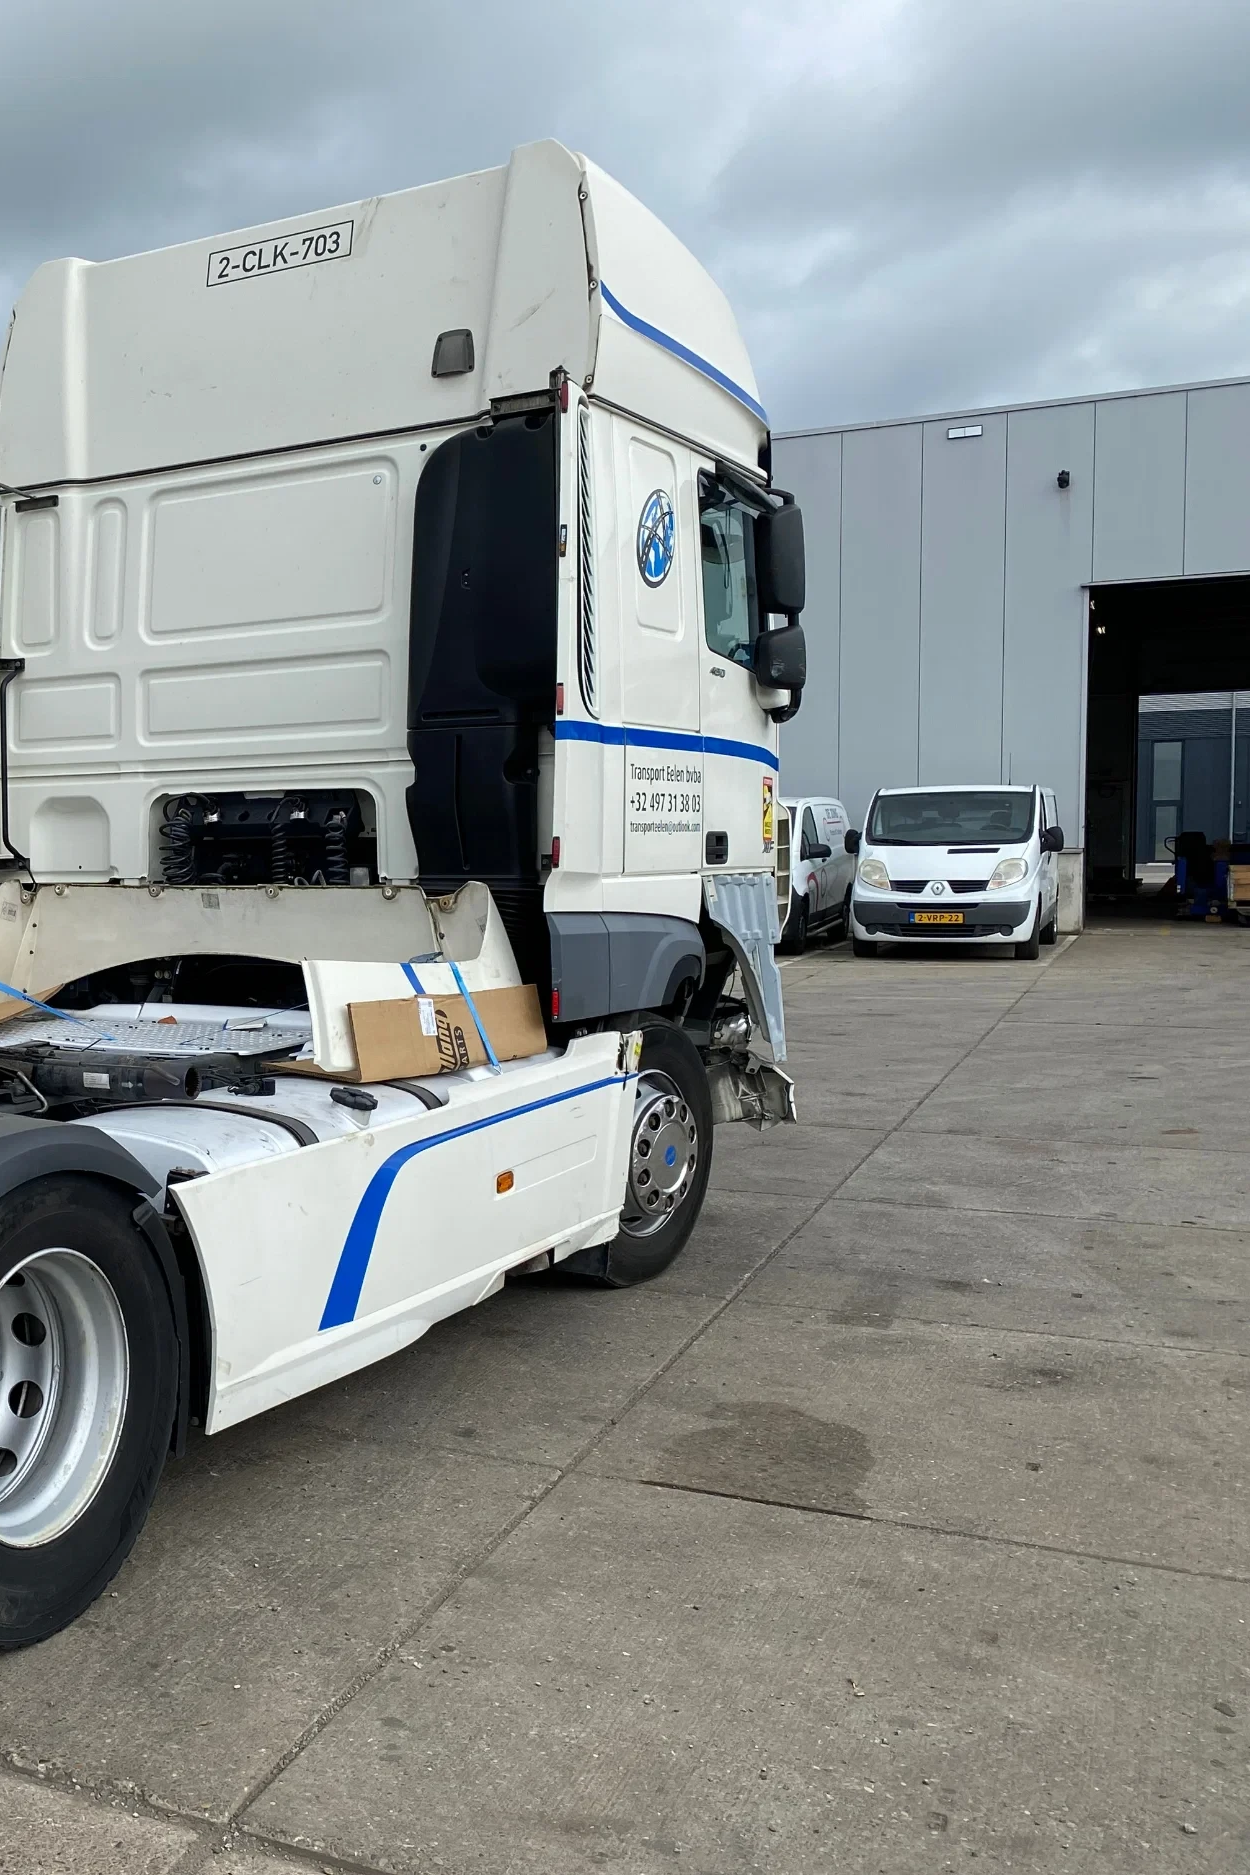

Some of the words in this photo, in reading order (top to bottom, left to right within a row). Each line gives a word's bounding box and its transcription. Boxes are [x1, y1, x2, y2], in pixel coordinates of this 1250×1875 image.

[217, 231, 341, 280] 2-CLK-703
[630, 763, 665, 786] Transport
[666, 763, 685, 783] Eelen
[686, 764, 702, 784] bvba
[630, 791, 647, 812] +32
[649, 792, 666, 812] 497
[667, 792, 677, 813] 31
[679, 793, 690, 813] 38
[691, 794, 701, 813] 03
[630, 819, 701, 836] transporteelen@outlook.com
[917, 914, 960, 922] 2-VRP-22
